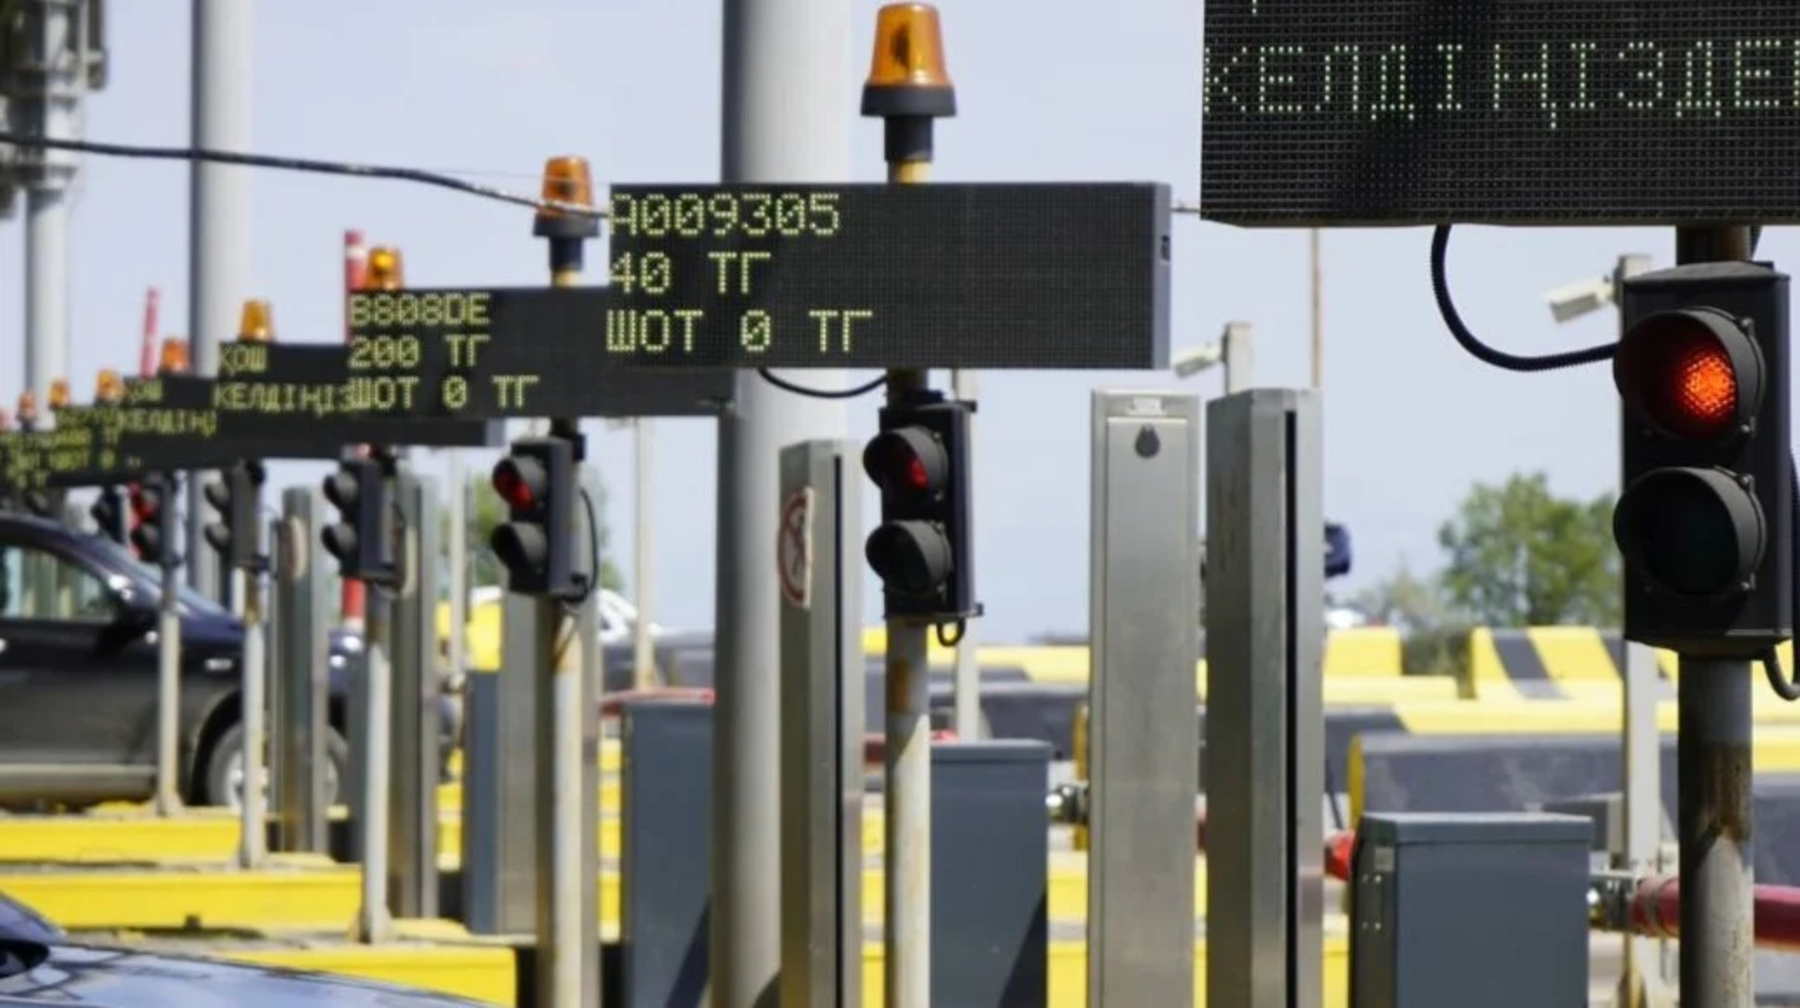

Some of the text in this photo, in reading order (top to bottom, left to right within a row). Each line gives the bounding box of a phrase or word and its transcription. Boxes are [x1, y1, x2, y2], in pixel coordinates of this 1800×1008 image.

[1203, 41, 1800, 129] КЕЛДІҢІЗДЕ
[608, 192, 840, 236] A009305
[609, 251, 773, 294] 40 ТГ
[348, 334, 492, 368] 200 ТГ
[606, 309, 874, 353] ШОТ 0 ТГ
[350, 374, 541, 409] ШОТ 0 ТГ
